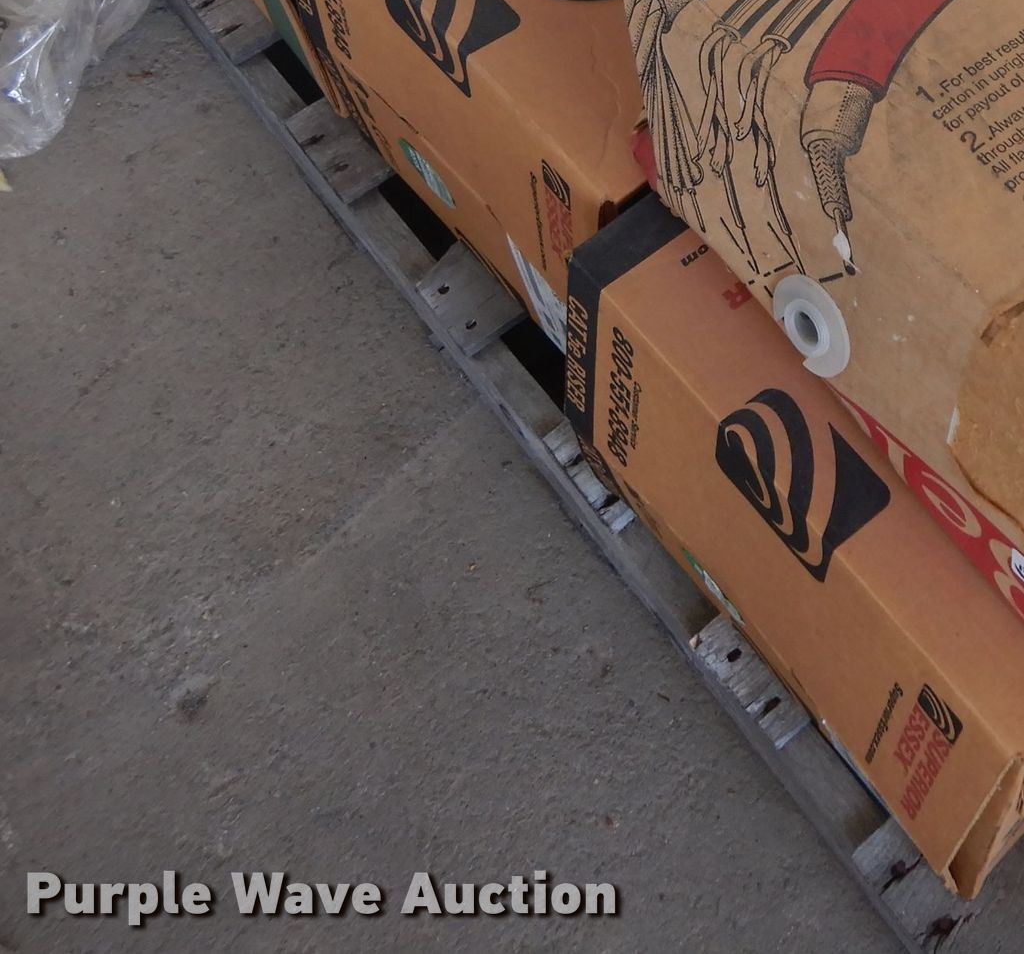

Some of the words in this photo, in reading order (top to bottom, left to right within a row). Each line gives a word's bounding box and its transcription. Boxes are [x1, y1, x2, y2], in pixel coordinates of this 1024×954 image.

[939, 74, 966, 95] For
[968, 52, 999, 77] best
[932, 90, 977, 121] carton
[974, 78, 989, 94] in
[942, 117, 965, 133] for
[965, 85, 1014, 120] payout
[991, 160, 1010, 178] All
[568, 295, 588, 341] CAT
[567, 354, 586, 414] RISER
[607, 326, 634, 468] 800-551-8948
[893, 704, 931, 775] ESSEX
[900, 729, 951, 821] SUPERIOR
